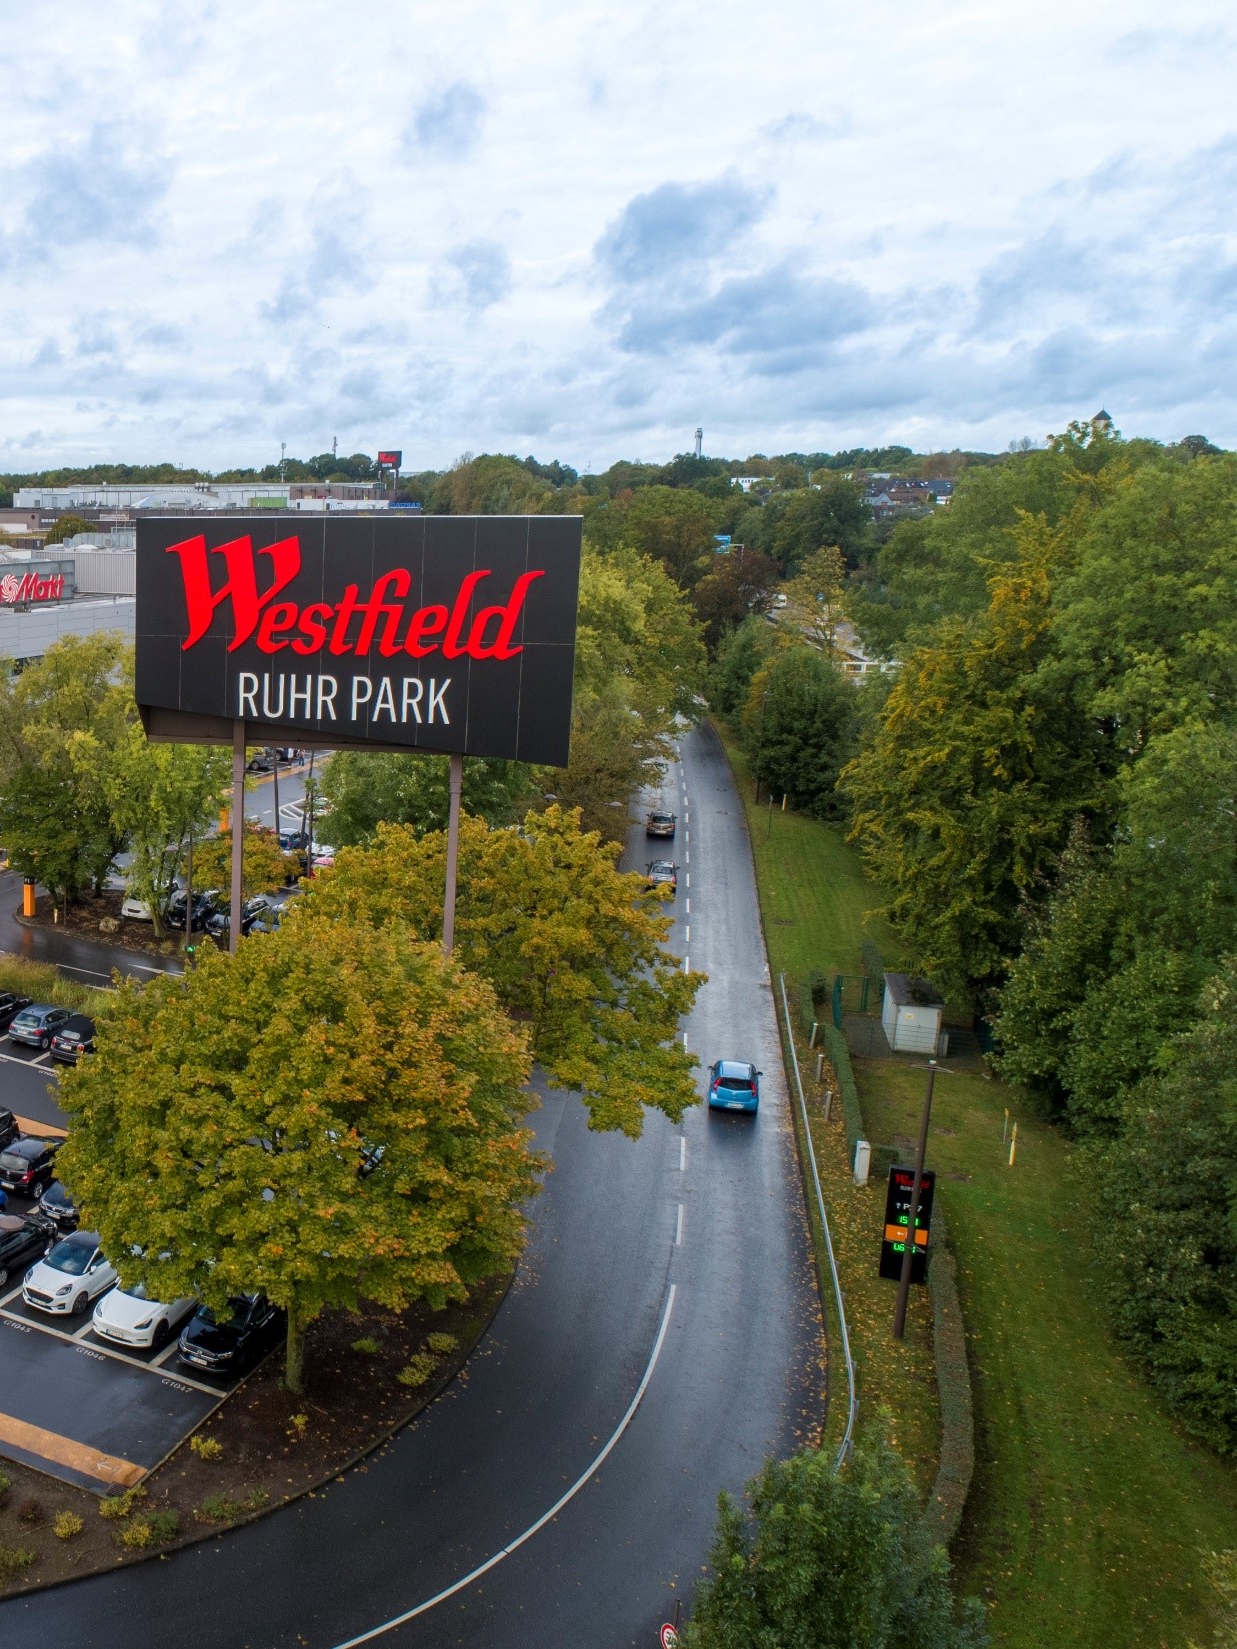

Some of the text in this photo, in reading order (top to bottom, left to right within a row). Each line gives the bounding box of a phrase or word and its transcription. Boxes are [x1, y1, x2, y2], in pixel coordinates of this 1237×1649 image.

[14, 572, 65, 600] Markt
[165, 534, 546, 660] Westfield
[238, 672, 452, 725] RUHR PARK
[3, 1319, 33, 1334] G1045
[75, 1346, 106, 1361] G1046
[161, 1378, 193, 1393] G1047
